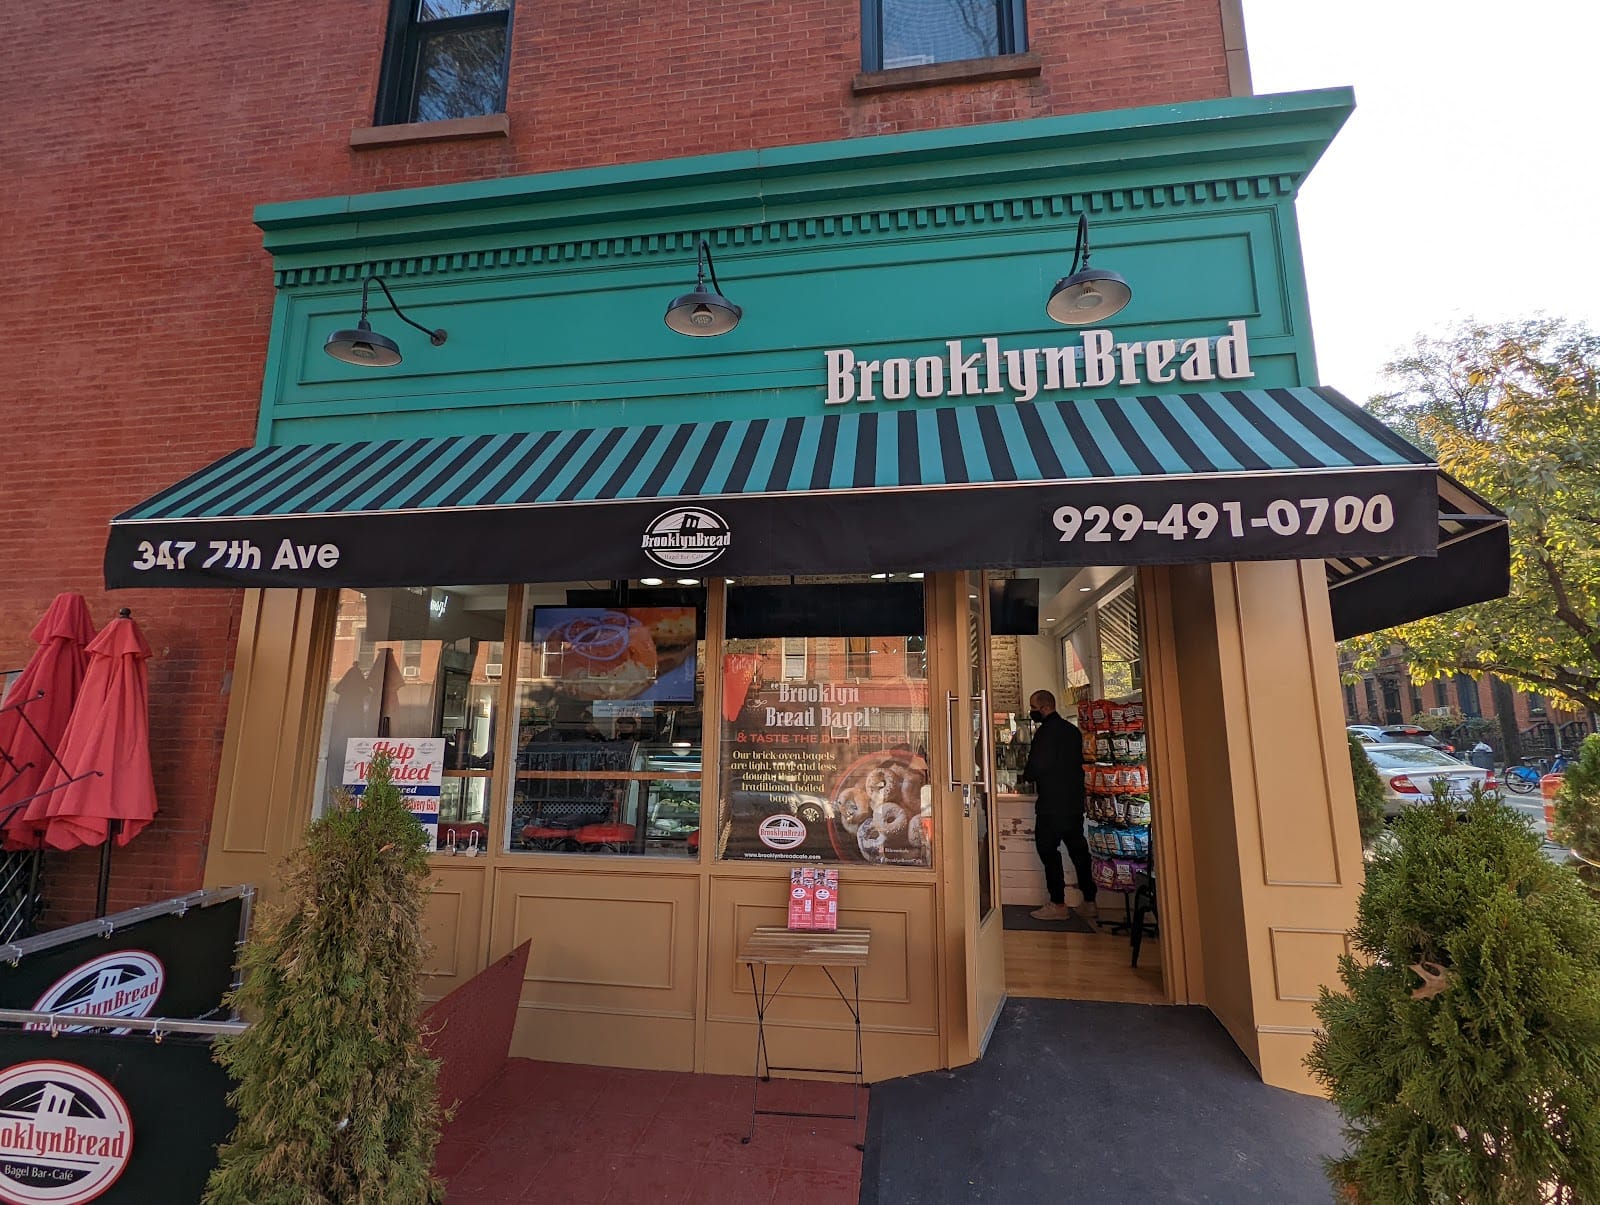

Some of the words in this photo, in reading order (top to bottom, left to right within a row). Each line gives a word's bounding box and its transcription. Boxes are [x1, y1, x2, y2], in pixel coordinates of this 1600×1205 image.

[823, 320, 1255, 405] BrooklynBread
[1052, 494, 1394, 542] 929-491-0700
[641, 532, 731, 548] BrooklynBread
[133, 540, 196, 570] 347
[202, 540, 262, 569] 7th
[271, 539, 340, 569] Ave
[765, 707, 815, 727] Bread
[736, 732, 747, 743] &
[750, 733, 790, 743] TASTE
[794, 733, 818, 743] THE
[372, 742, 415, 764] Help
[733, 750, 751, 760] Our
[803, 751, 835, 762] bagels
[354, 762, 432, 780] Wnted
[731, 762, 748, 770] are
[797, 762, 816, 770] and
[817, 761, 837, 771] less
[802, 773, 824, 783] your
[741, 783, 793, 792] traditional
[795, 783, 825, 792] boiled
[4, 1164, 29, 1178] Bagel
[31, 1168, 47, 1178] Bar
[52, 1169, 74, 1181] Café
